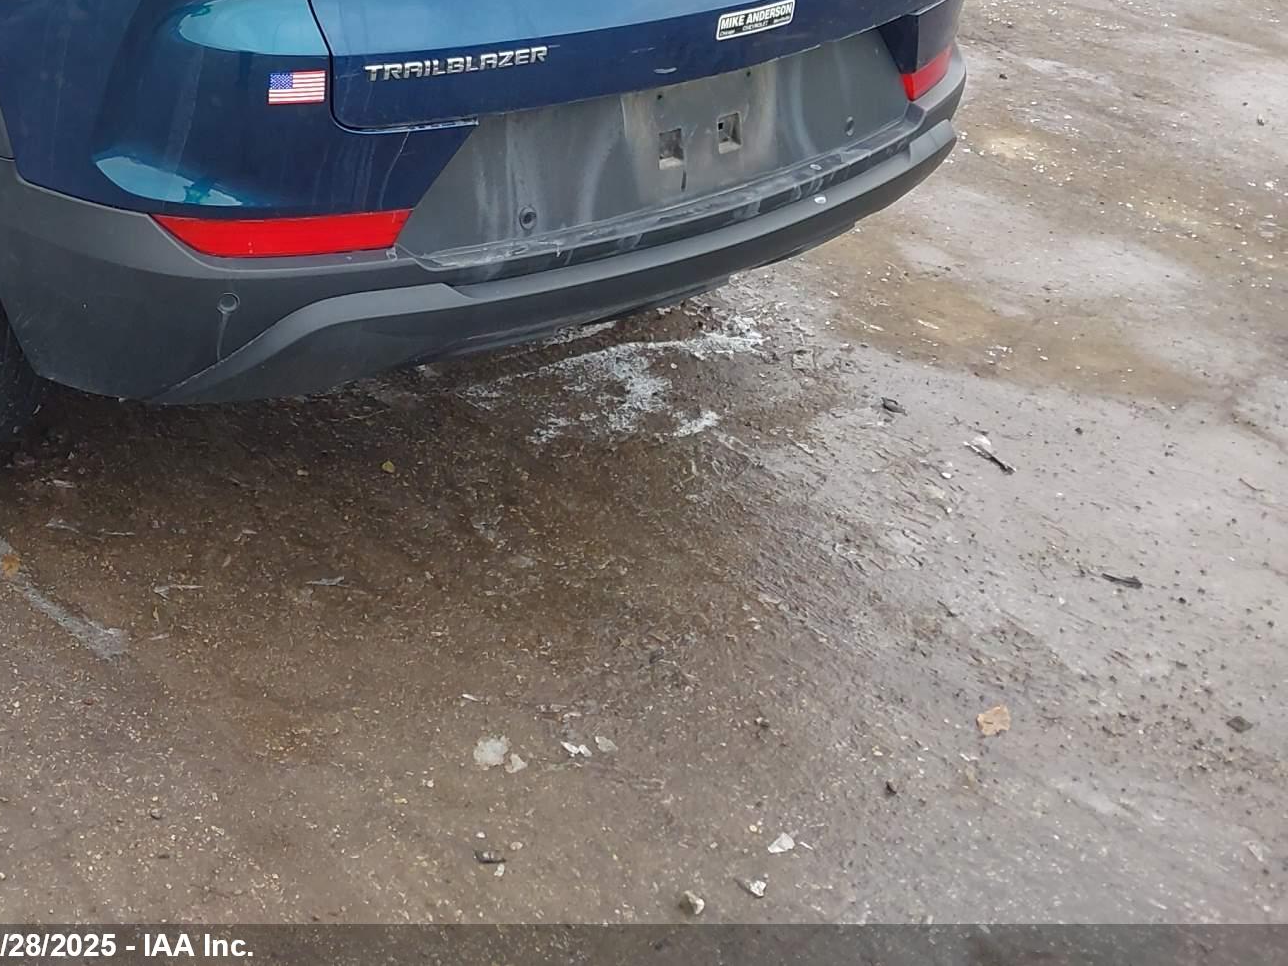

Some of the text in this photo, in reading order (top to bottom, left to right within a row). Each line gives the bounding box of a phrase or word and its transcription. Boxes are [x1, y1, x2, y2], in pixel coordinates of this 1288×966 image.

[720, 15, 746, 30] MIKE
[746, 3, 792, 24] ANDERSON
[364, 46, 548, 82] TRAILBLAZER
